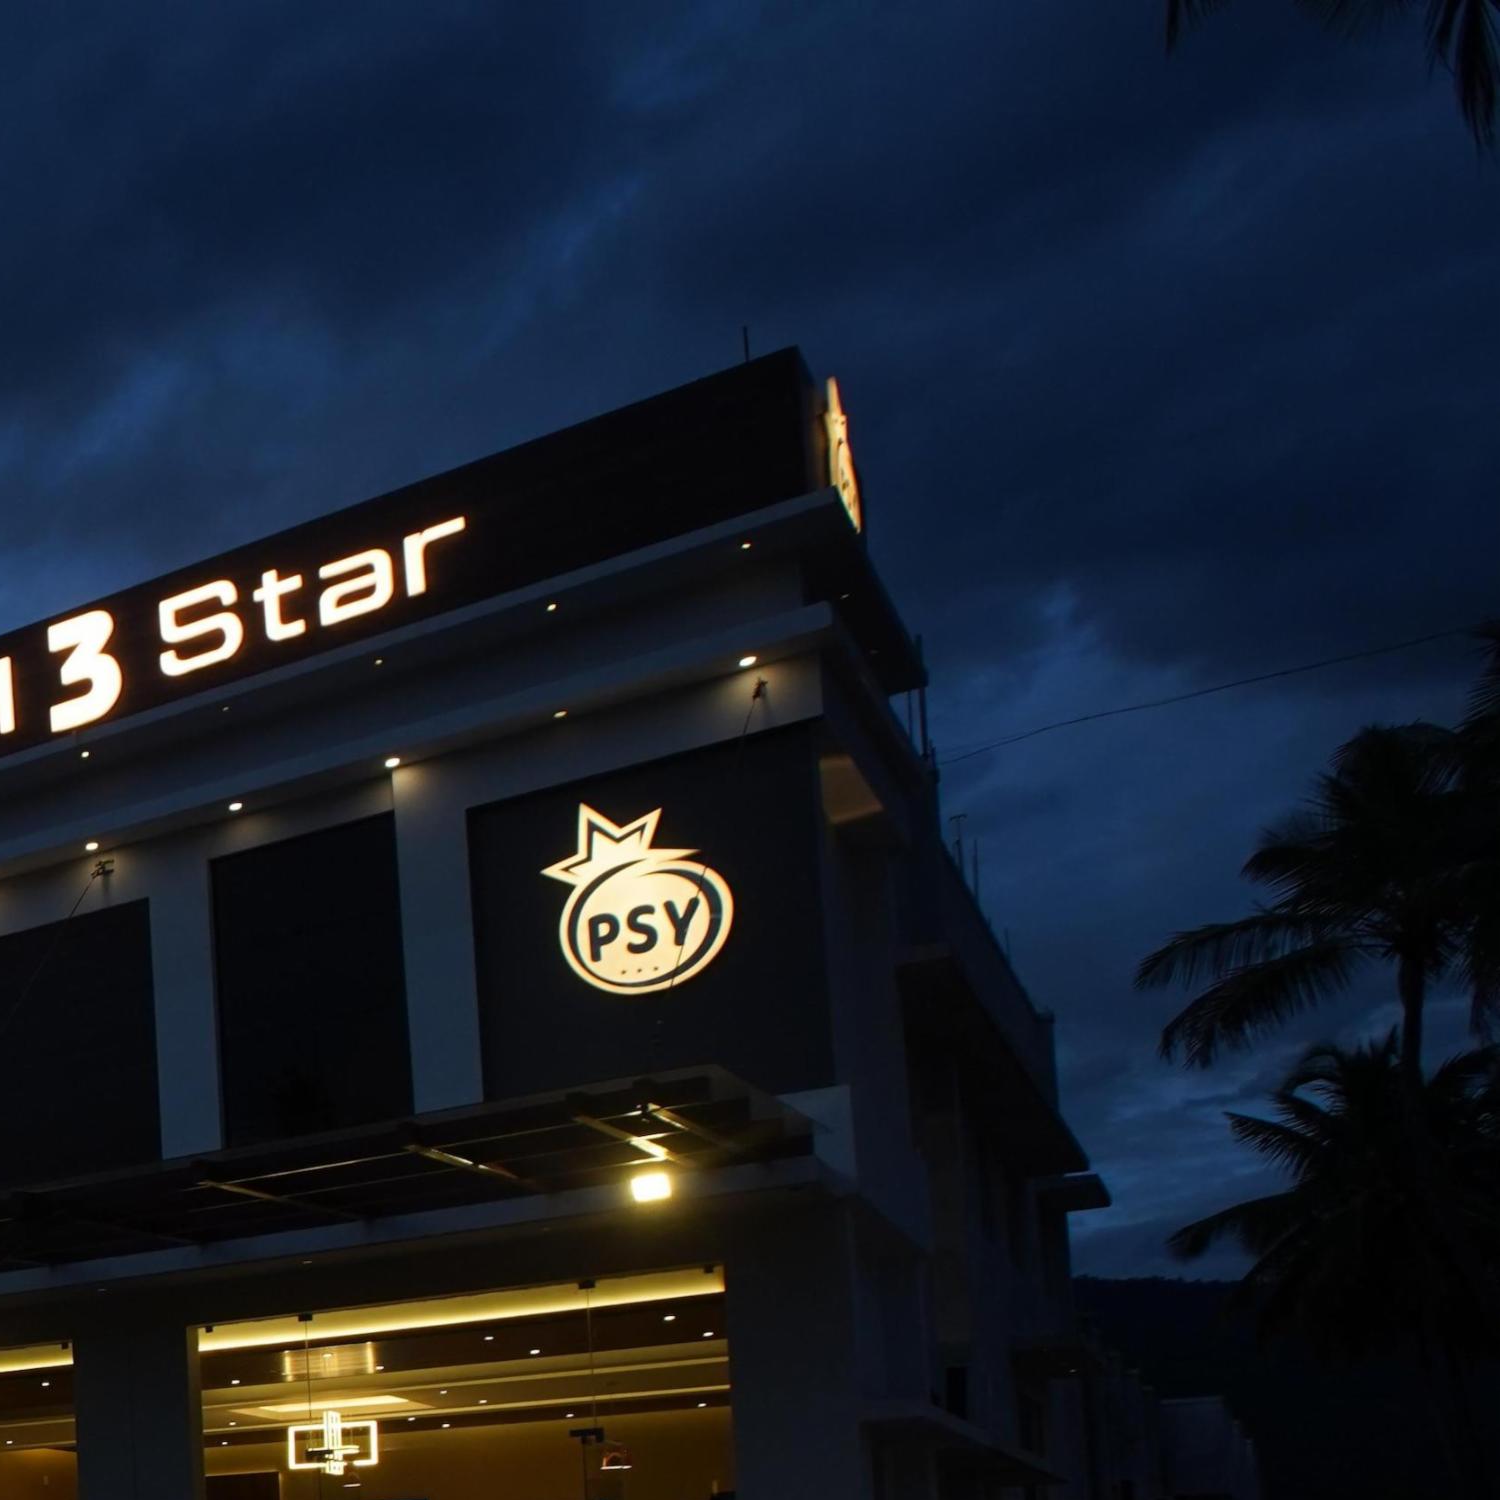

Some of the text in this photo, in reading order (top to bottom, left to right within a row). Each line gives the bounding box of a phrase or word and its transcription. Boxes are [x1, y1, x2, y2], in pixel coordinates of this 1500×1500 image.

[47, 610, 122, 732] 3
[158, 517, 465, 677] Star
[588, 896, 700, 962] PSY
